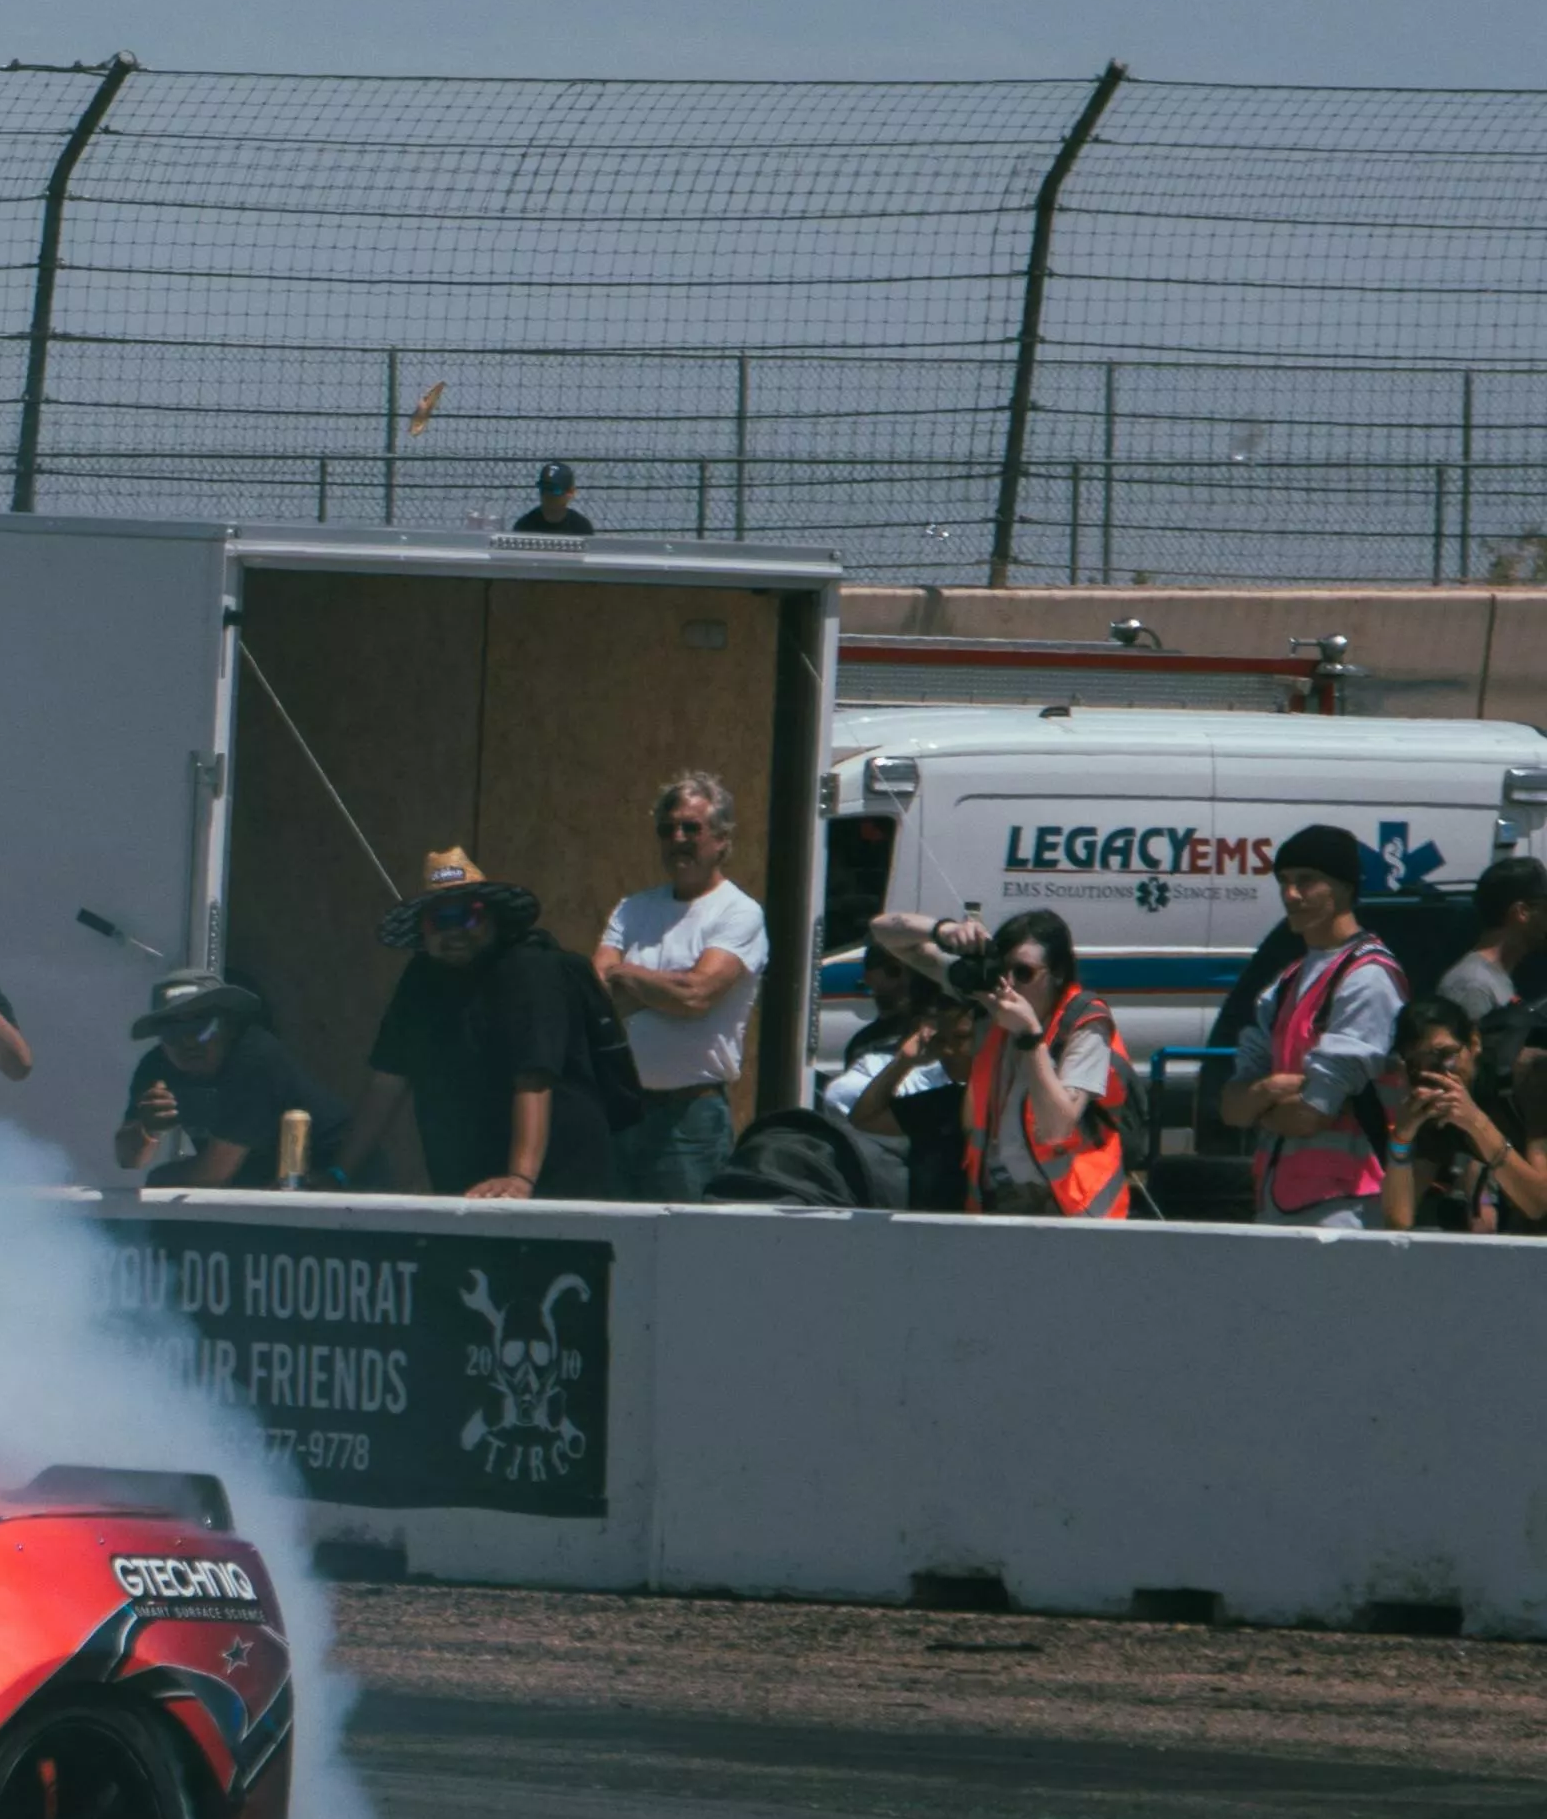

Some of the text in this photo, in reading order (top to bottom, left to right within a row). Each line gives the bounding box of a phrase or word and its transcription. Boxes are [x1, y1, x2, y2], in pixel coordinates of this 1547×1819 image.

[1225, 886, 1258, 900] 1992
[181, 1250, 230, 1315] DO
[245, 1253, 418, 1325] HOODRAT
[248, 1341, 407, 1414] FRIENDS
[114, 1556, 258, 1601] GTECHNIQ
[135, 1605, 171, 1618] SMART
[175, 1605, 223, 1620] SURFACE
